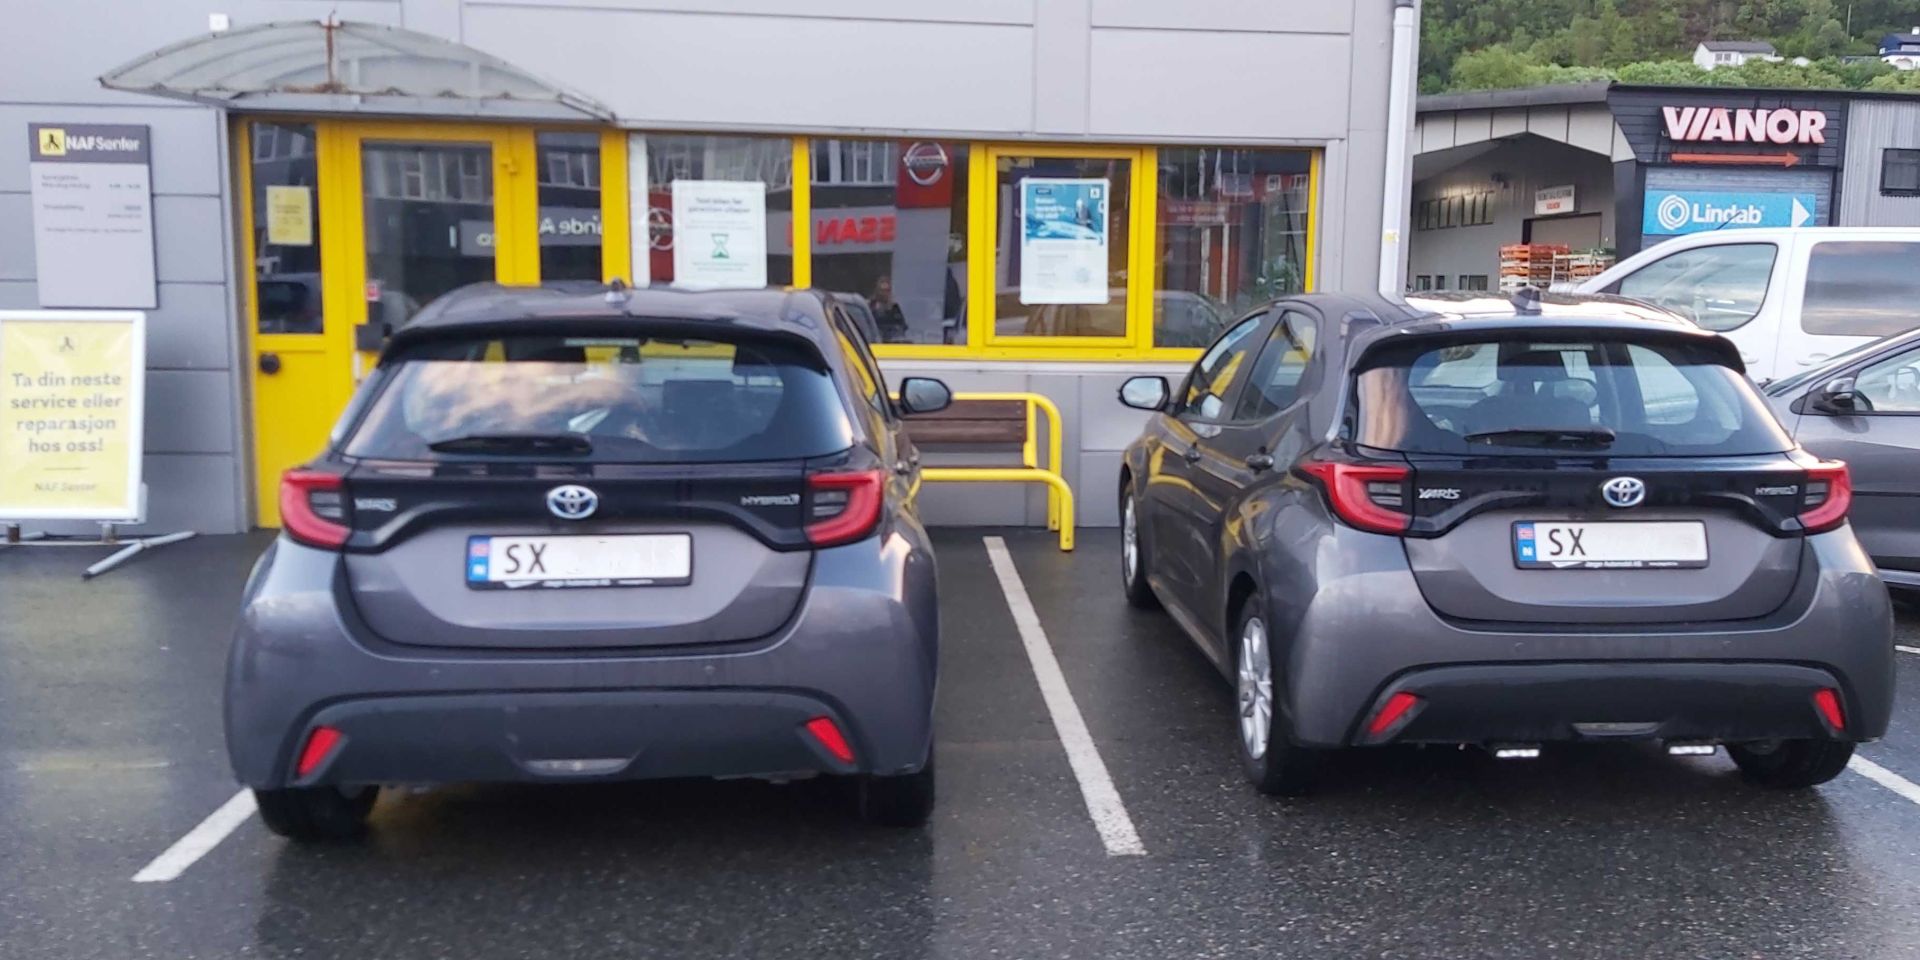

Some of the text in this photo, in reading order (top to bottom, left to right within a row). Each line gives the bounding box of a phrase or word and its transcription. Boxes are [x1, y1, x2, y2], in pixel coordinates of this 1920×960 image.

[1663, 106, 1827, 144] VIANOR
[1692, 203, 1762, 224] Lindab
[12, 372, 122, 387] Ta din neste
[10, 393, 123, 409] service eller
[16, 414, 117, 434] reparasjon
[28, 438, 104, 453] hos oss!
[1418, 488, 1461, 499] YARIS
[1548, 528, 1586, 556] SX
[505, 544, 546, 574] SX
